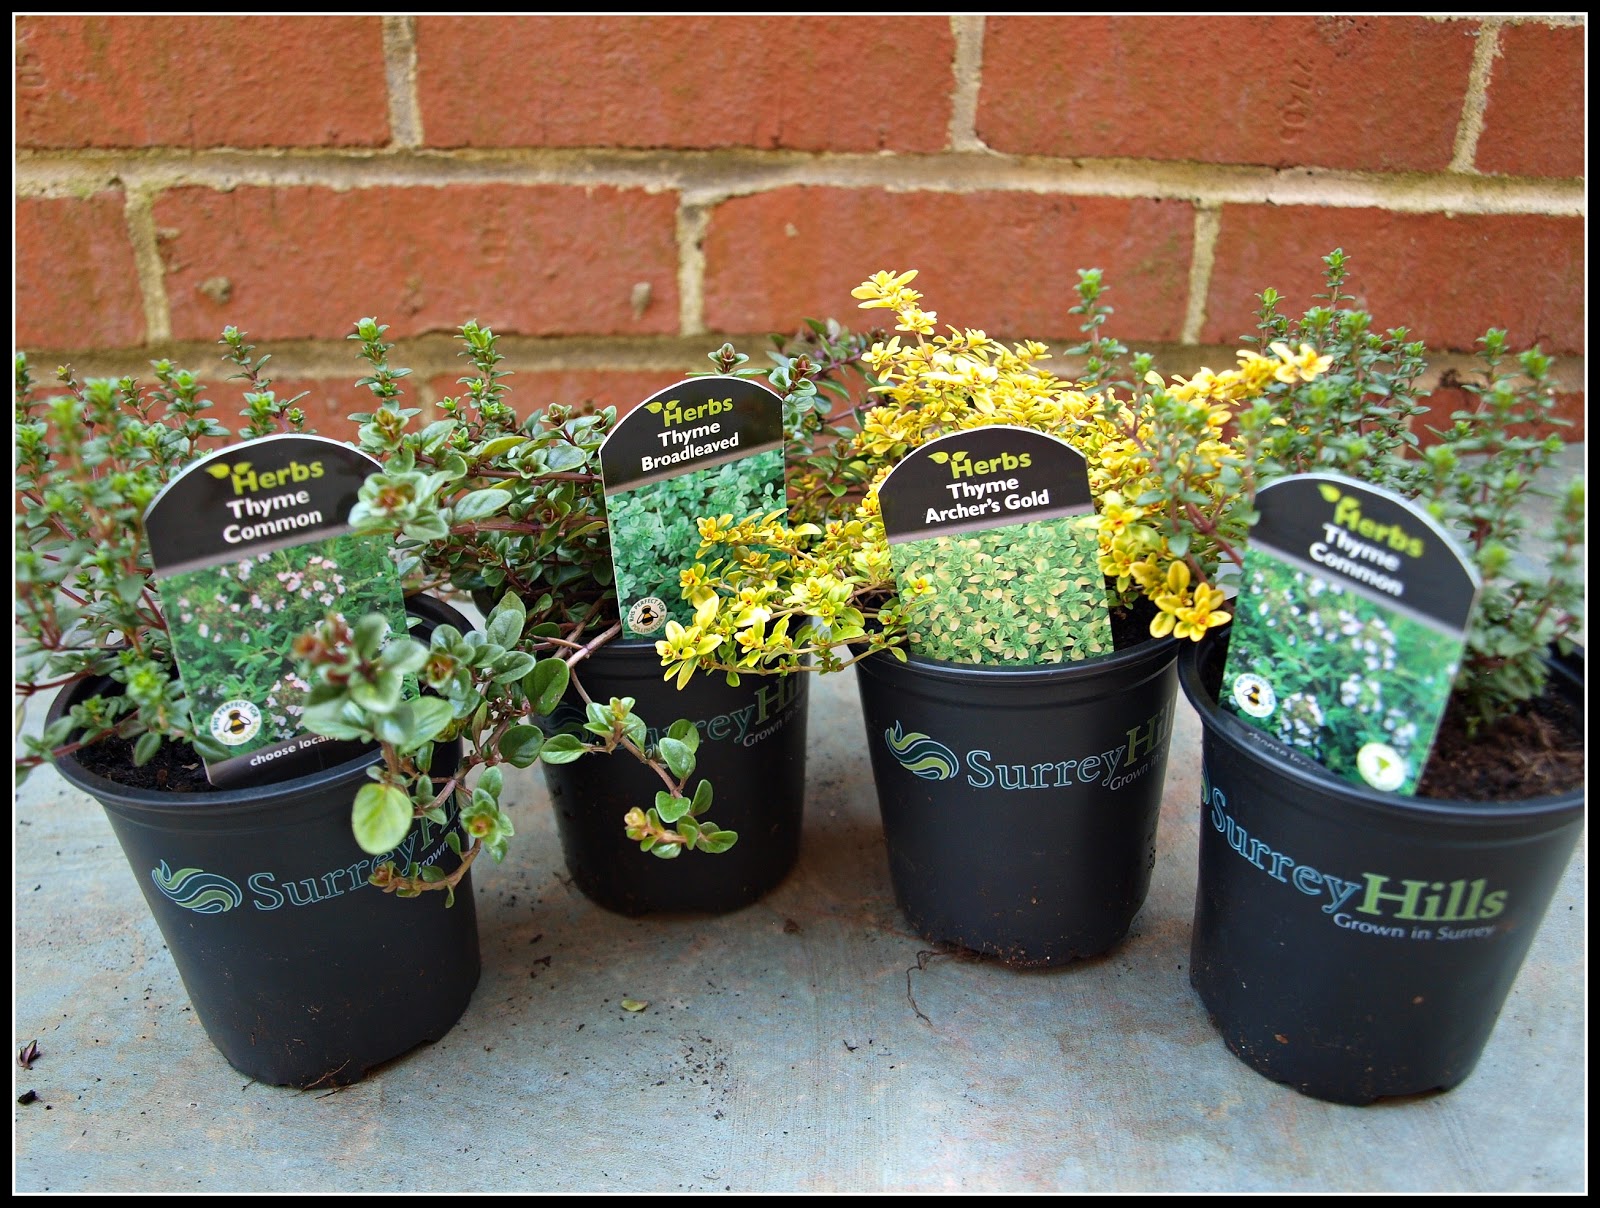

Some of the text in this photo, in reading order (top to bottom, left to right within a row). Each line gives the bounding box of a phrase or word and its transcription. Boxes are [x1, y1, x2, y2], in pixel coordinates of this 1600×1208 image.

[663, 397, 733, 428] Herbs
[657, 422, 721, 448] Thyme
[641, 432, 739, 472] Broadleaved
[950, 451, 1032, 480] Herbs
[229, 461, 325, 496] Herbs
[946, 477, 1019, 500] Thyme
[226, 490, 311, 519] Thyme
[925, 489, 1050, 524] Archer's Gold
[223, 509, 322, 544] Common
[1333, 497, 1425, 558] Herbs
[1322, 522, 1401, 572] Thyme
[1309, 541, 1405, 597] Common
[634, 598, 657, 610] PERFECT
[657, 602, 665, 612] FOR
[249, 744, 297, 767] choose
[1109, 763, 1149, 791] Grown
[1333, 912, 1496, 941] Grown in Surrey
